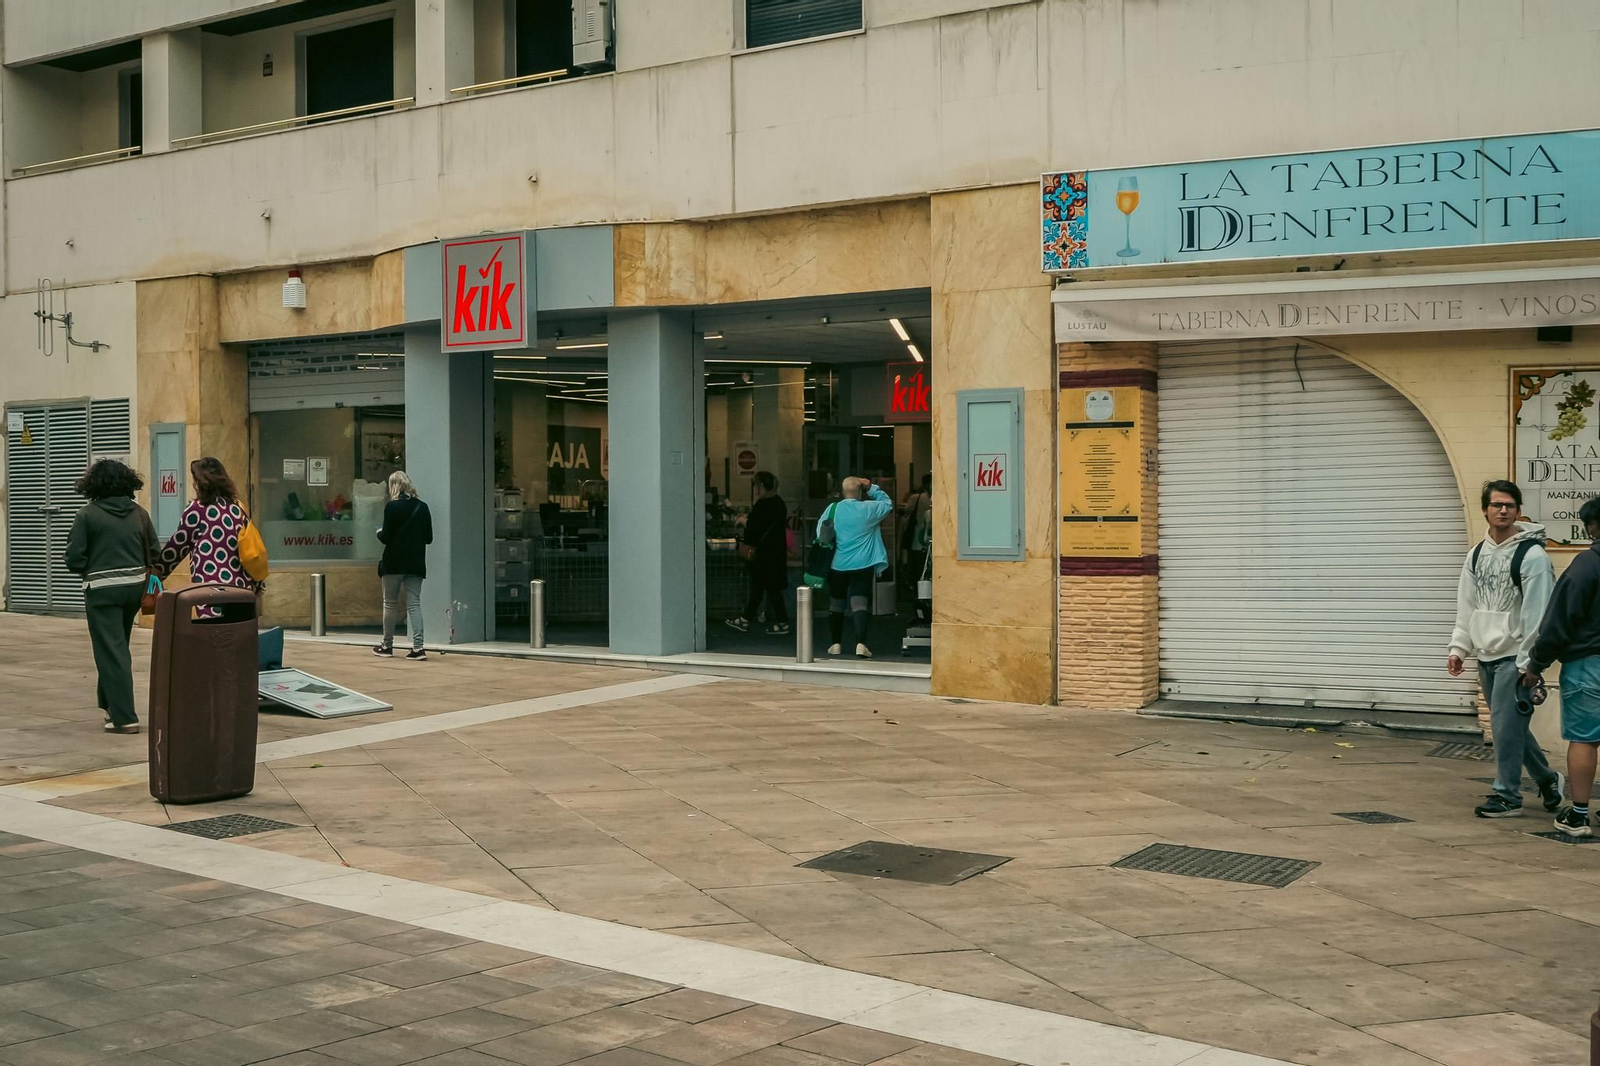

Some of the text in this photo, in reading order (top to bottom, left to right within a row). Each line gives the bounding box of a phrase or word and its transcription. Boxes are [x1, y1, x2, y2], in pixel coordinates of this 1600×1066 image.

[1179, 144, 1563, 201] LA TABERNA
[1177, 193, 1567, 254] DENFRENTE
[453, 246, 515, 333] kik
[1500, 293, 1597, 317] VINOS
[1067, 322, 1107, 331] LUSTAU
[1151, 300, 1463, 331] TABERNA DENFRENTE
[891, 367, 931, 413] kik
[547, 442, 590, 469] AJA
[976, 455, 1004, 487] kik
[161, 472, 177, 494] kik
[284, 533, 354, 546] www.kik.es
